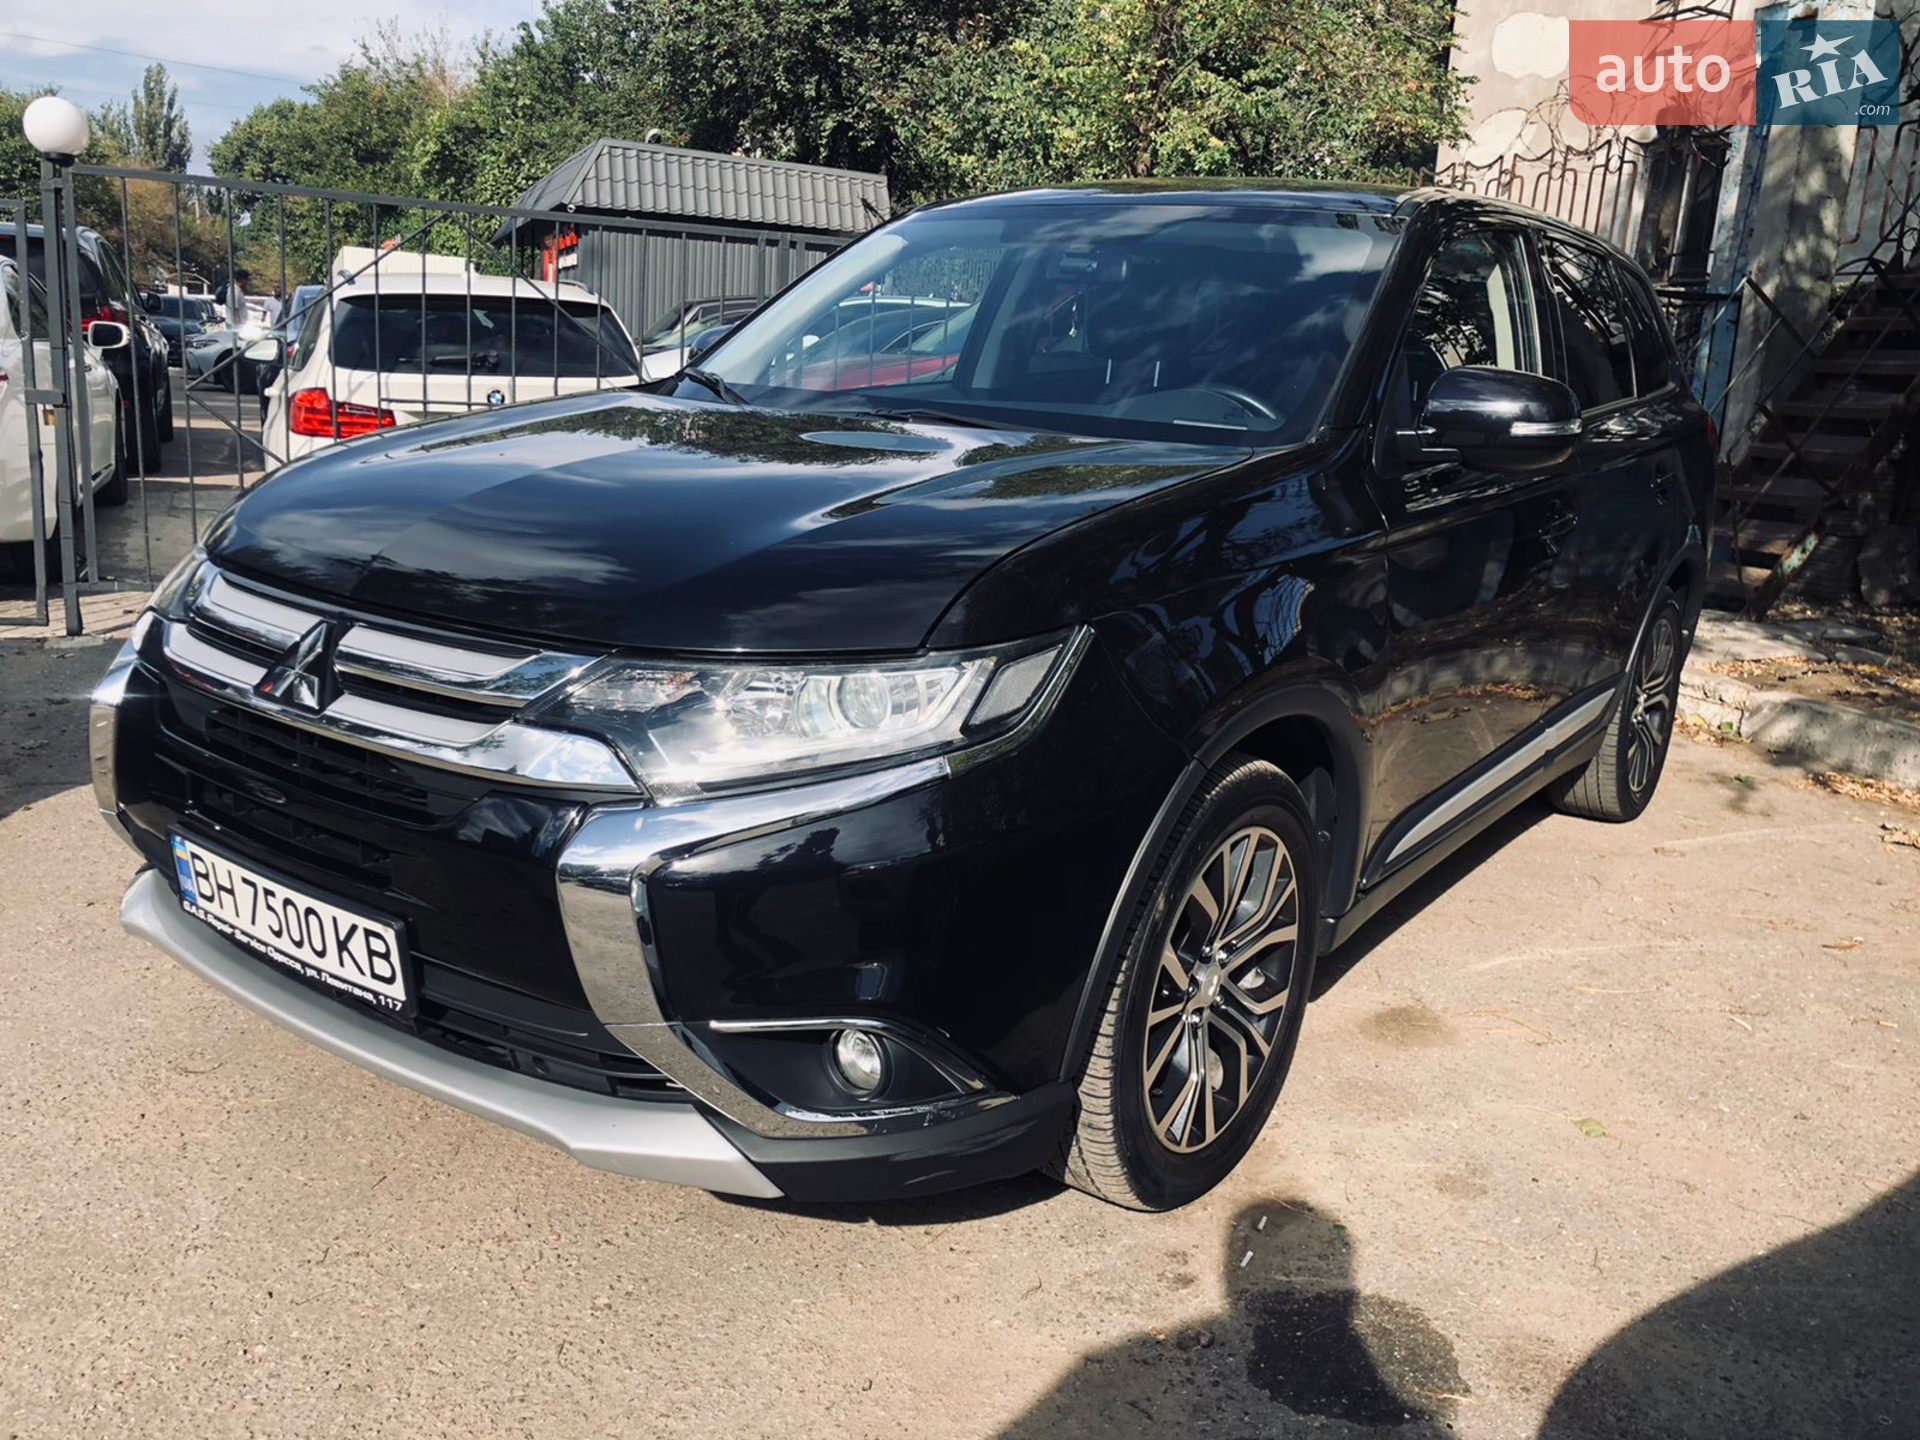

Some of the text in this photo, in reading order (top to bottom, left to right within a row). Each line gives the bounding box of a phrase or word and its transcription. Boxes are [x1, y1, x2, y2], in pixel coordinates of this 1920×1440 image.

[190, 851, 397, 985] BH 7500 KB
[234, 929, 267, 954] Service
[378, 995, 403, 1012] 117
